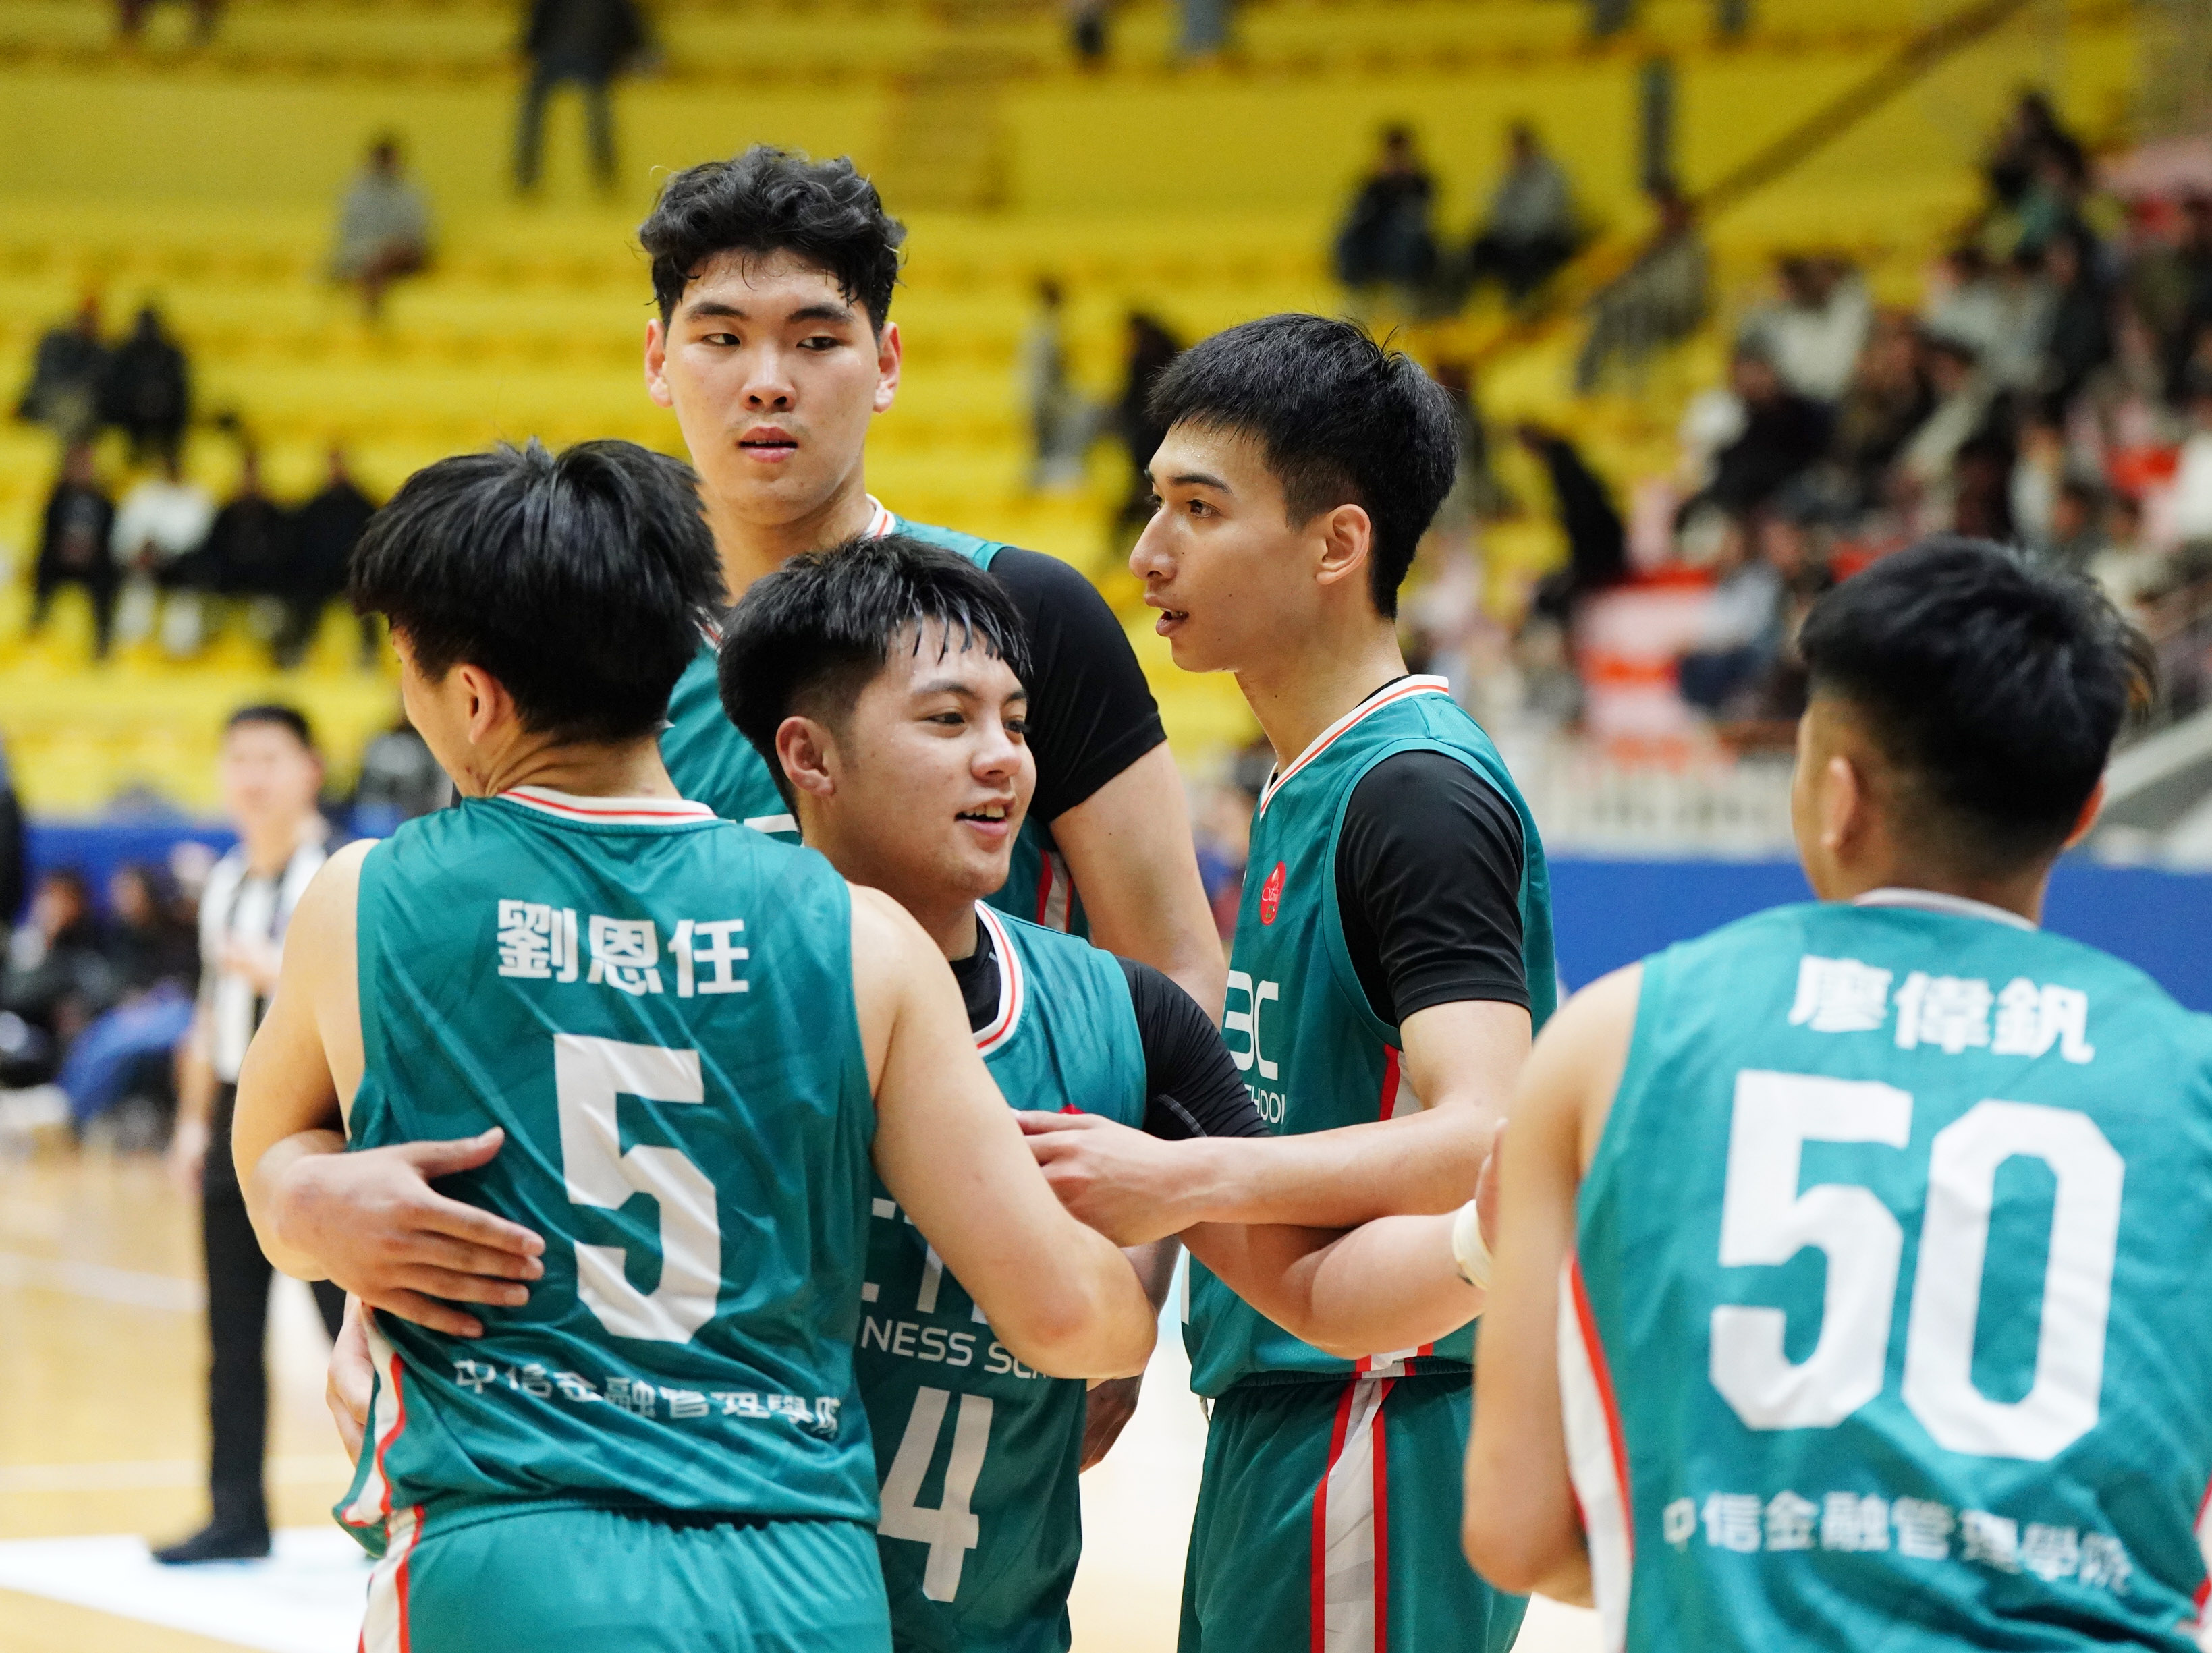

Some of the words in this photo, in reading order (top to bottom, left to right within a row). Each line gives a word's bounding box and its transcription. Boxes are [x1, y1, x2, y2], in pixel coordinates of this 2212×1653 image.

[497, 899, 749, 998] 劉恩任
[1788, 954, 2095, 1065] 廖偉釩
[553, 1032, 721, 1344] 5
[1709, 1069, 2126, 1461] 50
[878, 1386, 994, 1604] 4
